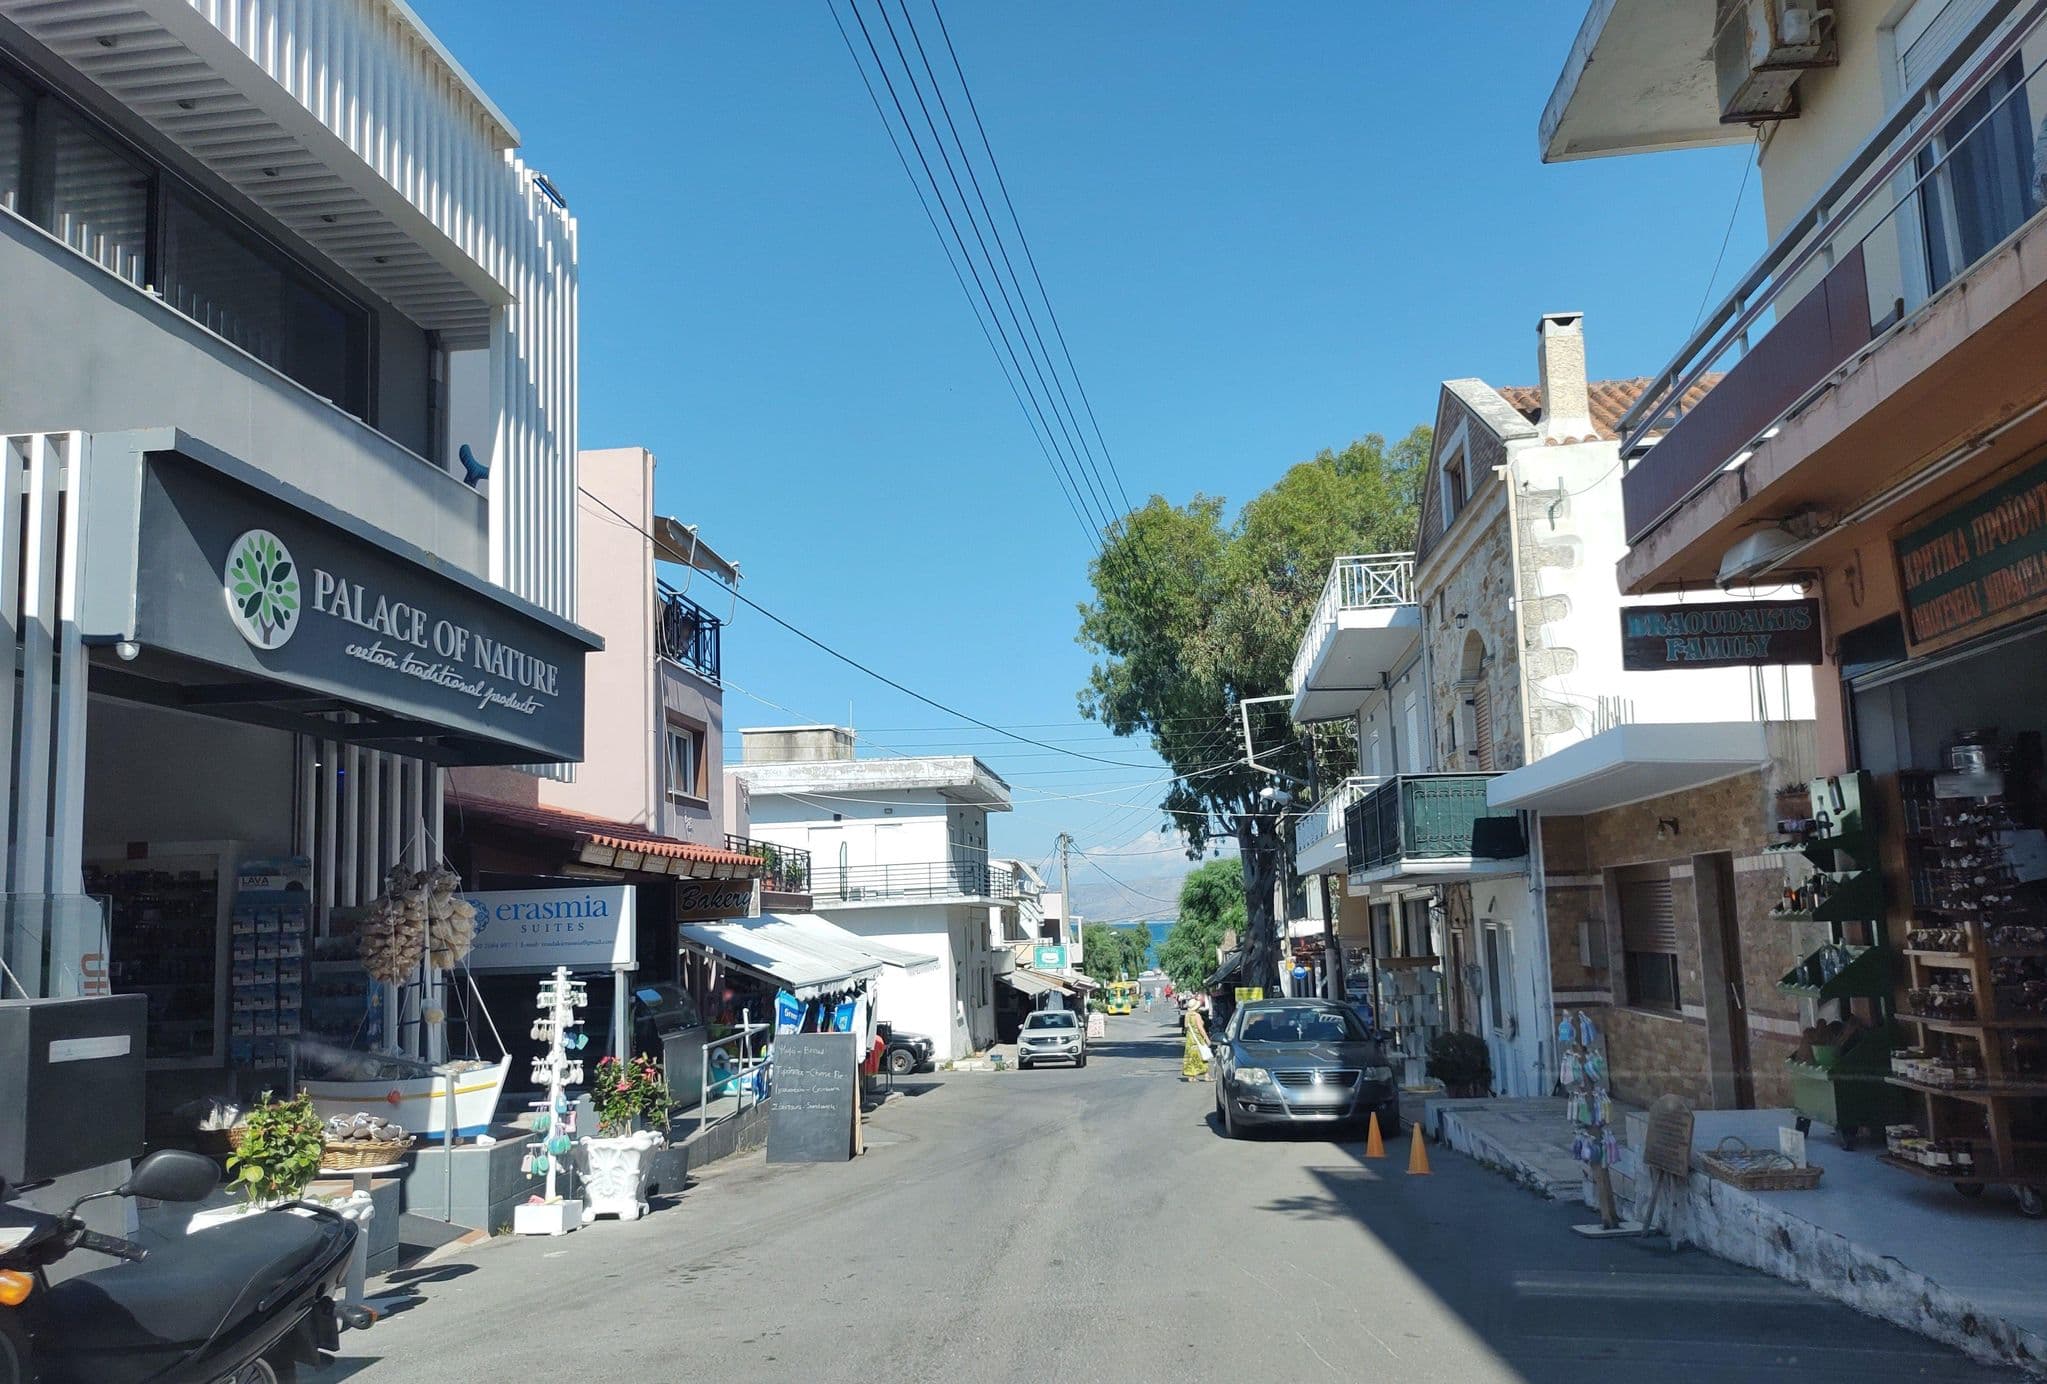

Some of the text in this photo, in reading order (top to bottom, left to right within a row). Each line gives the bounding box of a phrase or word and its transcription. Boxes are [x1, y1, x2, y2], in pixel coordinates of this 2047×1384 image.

[311, 569, 558, 696] PALACE OF NATURE
[1666, 635, 1771, 662] FAMILY
[345, 641, 545, 715] cretan traditional products
[241, 876, 269, 887] LAVA
[496, 895, 608, 921] erasmia
[681, 883, 755, 915] Bakery
[520, 923, 584, 934] SUITES
